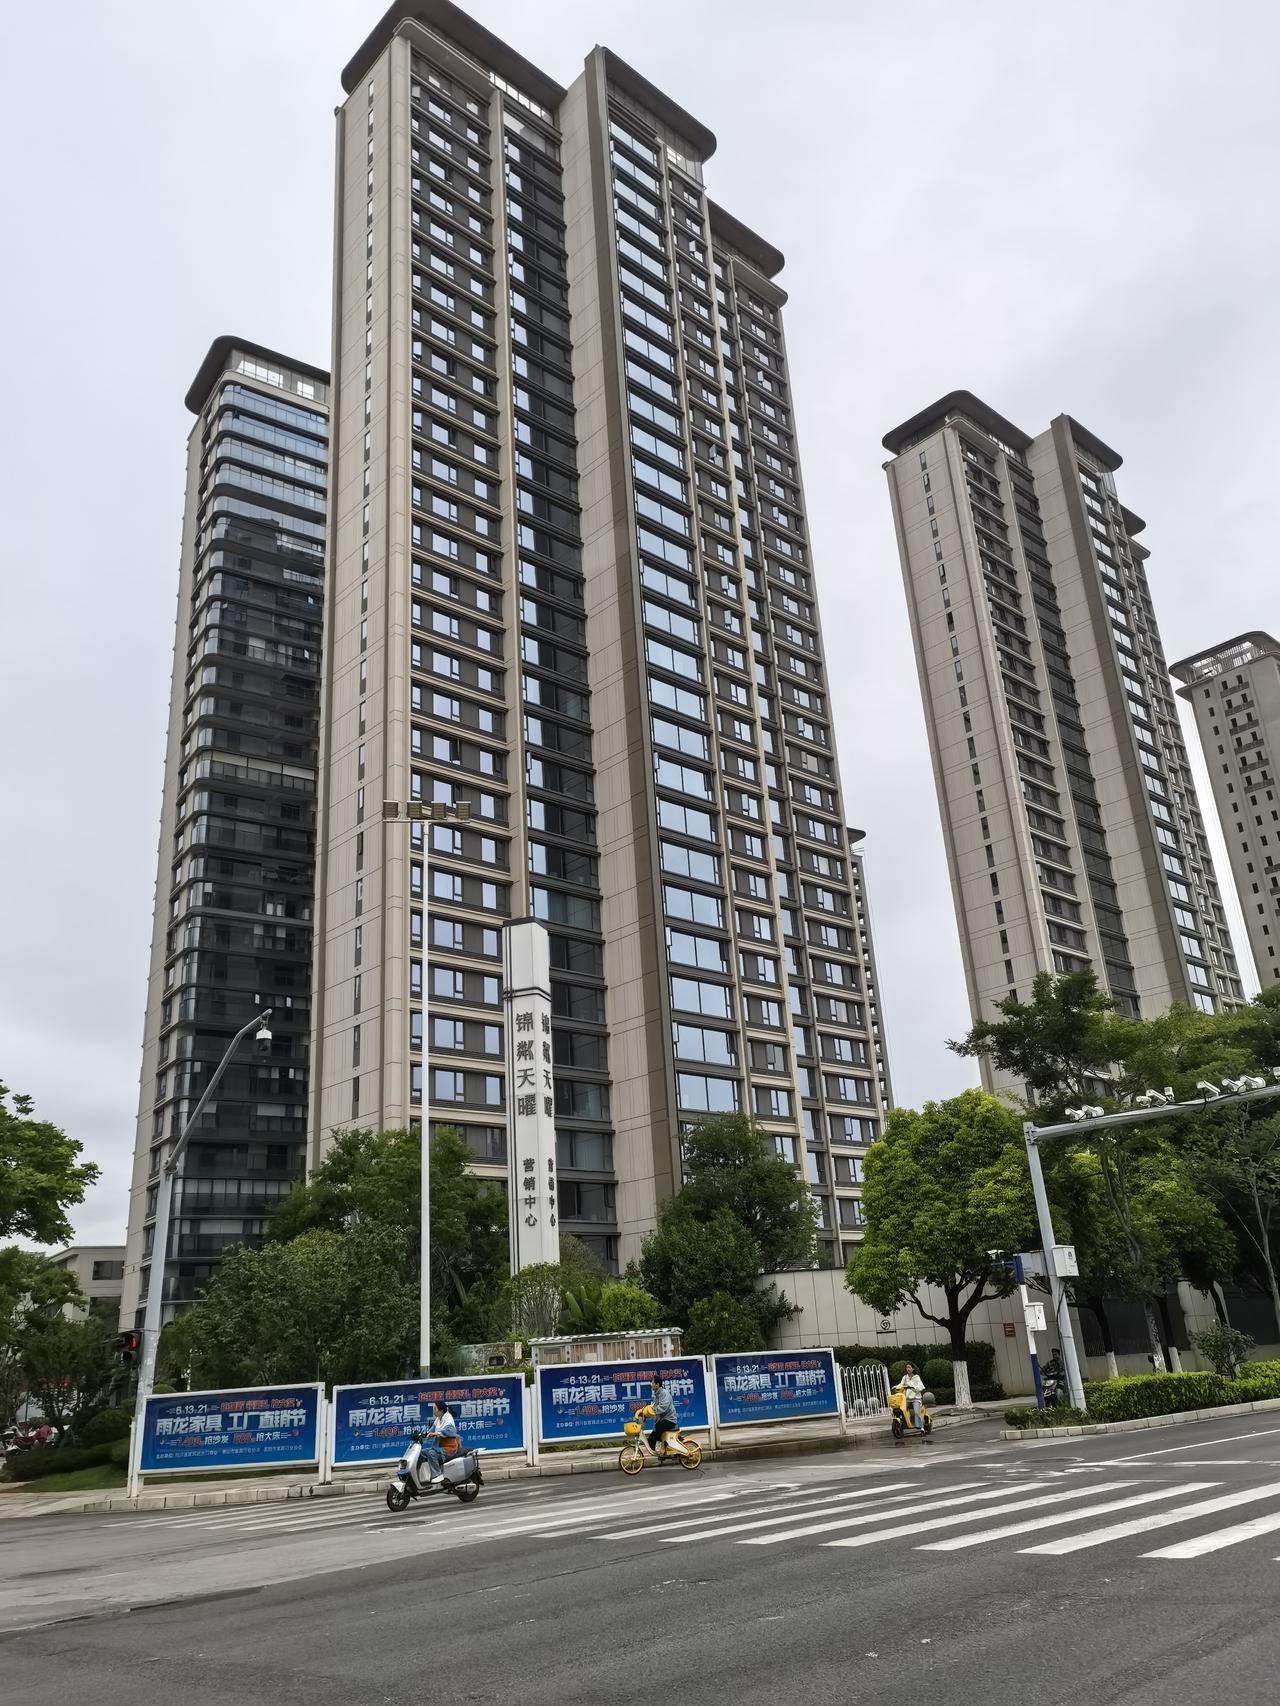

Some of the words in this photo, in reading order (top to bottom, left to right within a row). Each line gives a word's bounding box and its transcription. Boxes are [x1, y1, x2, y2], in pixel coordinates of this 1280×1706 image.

[522, 1157, 538, 1227] 营销中心
[551, 1384, 617, 1405] 雨龙家具
[621, 1378, 695, 1400] 工厂销节
[723, 1373, 772, 1392] 雨龙家具
[774, 1369, 827, 1389] 工厂直销节
[155, 1414, 223, 1436] 雨龙家具
[227, 1408, 307, 1431] 工厂直销节
[348, 1403, 421, 1428] 雨龙家具
